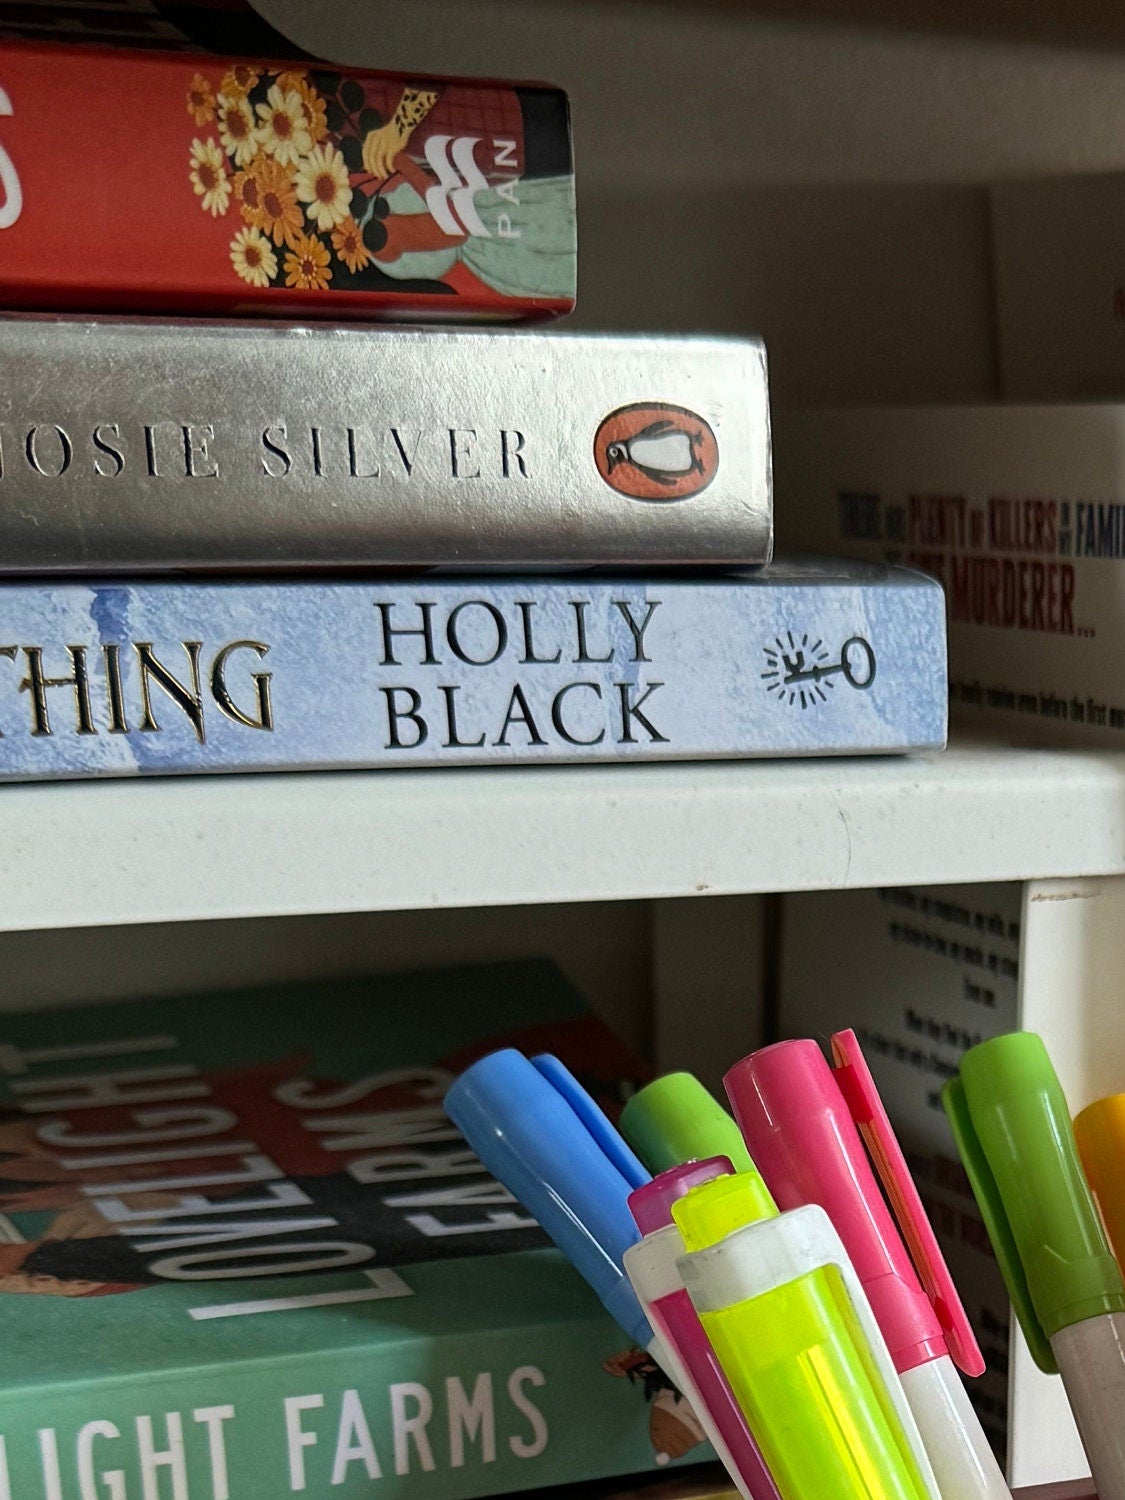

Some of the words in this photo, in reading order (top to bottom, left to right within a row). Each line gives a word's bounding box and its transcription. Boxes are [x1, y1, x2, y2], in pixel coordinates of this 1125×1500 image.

[497, 138, 519, 240] PAN
[0, 423, 219, 480] OSIE
[261, 424, 534, 481] SILVER
[988, 498, 1057, 553] KILLERS
[949, 554, 1096, 638] MURDERER...
[373, 599, 664, 666] HOLLY
[379, 682, 671, 749] BLACK
[1086, 696, 1106, 727] first
[284, 1364, 550, 1492] FARMS
